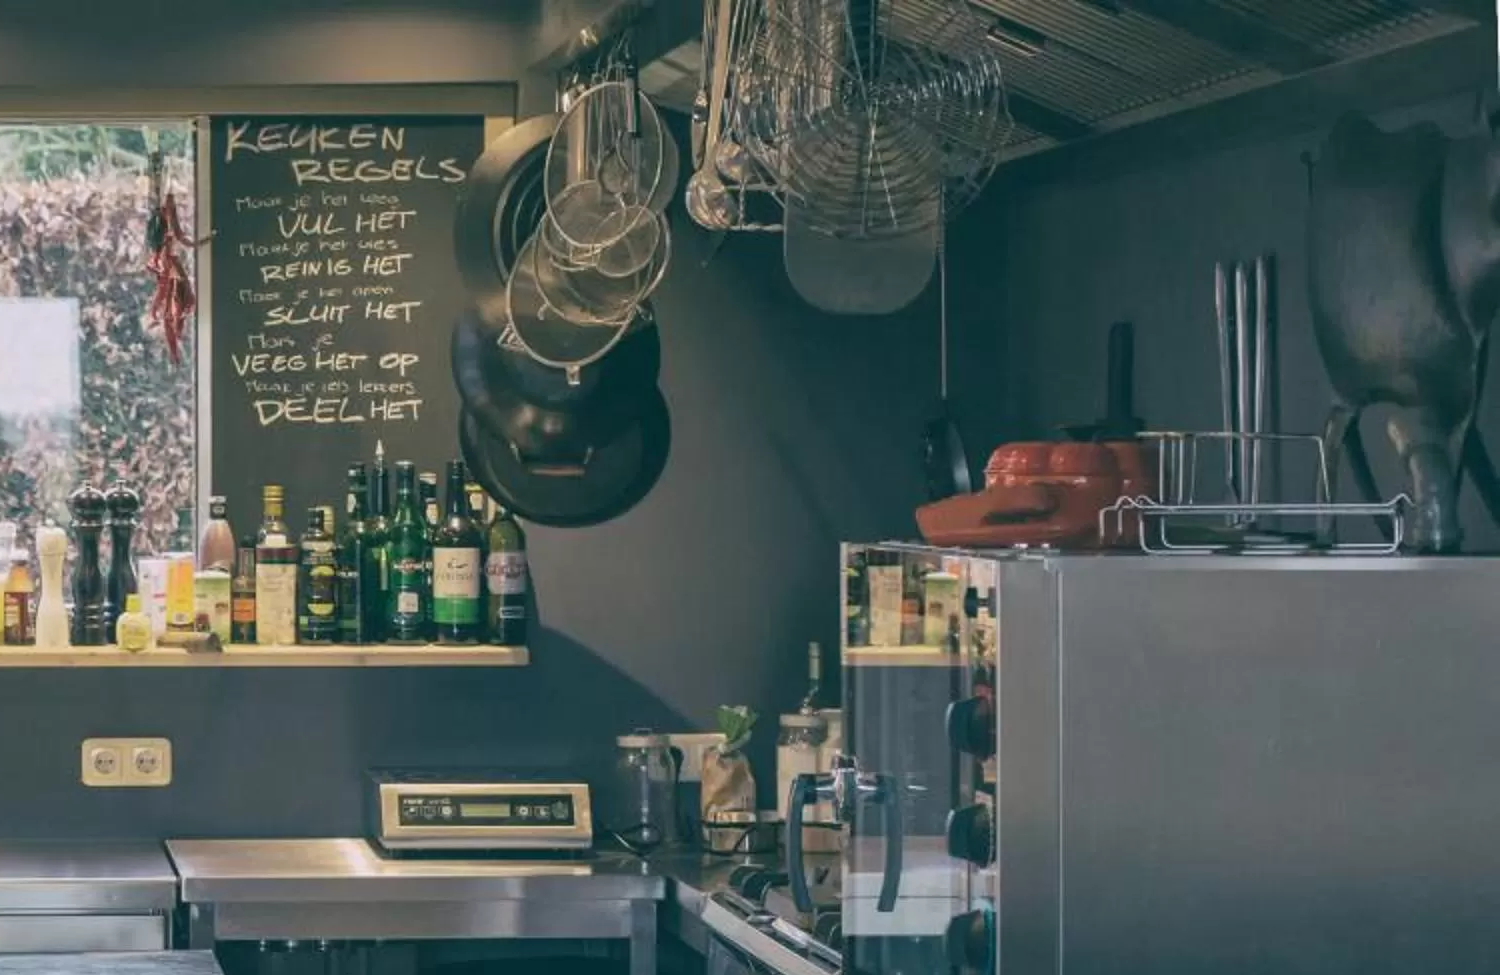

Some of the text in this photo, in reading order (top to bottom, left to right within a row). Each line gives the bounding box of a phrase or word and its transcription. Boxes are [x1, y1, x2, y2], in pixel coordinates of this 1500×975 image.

[225, 120, 405, 163] KEUKEN
[290, 156, 466, 186] REGELS
[289, 193, 312, 210] je
[277, 210, 417, 238] VUL HET
[260, 253, 414, 284] REINIG HET
[263, 301, 423, 327] SLUIT HET
[231, 352, 420, 377] VEEG HET OP
[253, 397, 423, 426] DEEL HET
